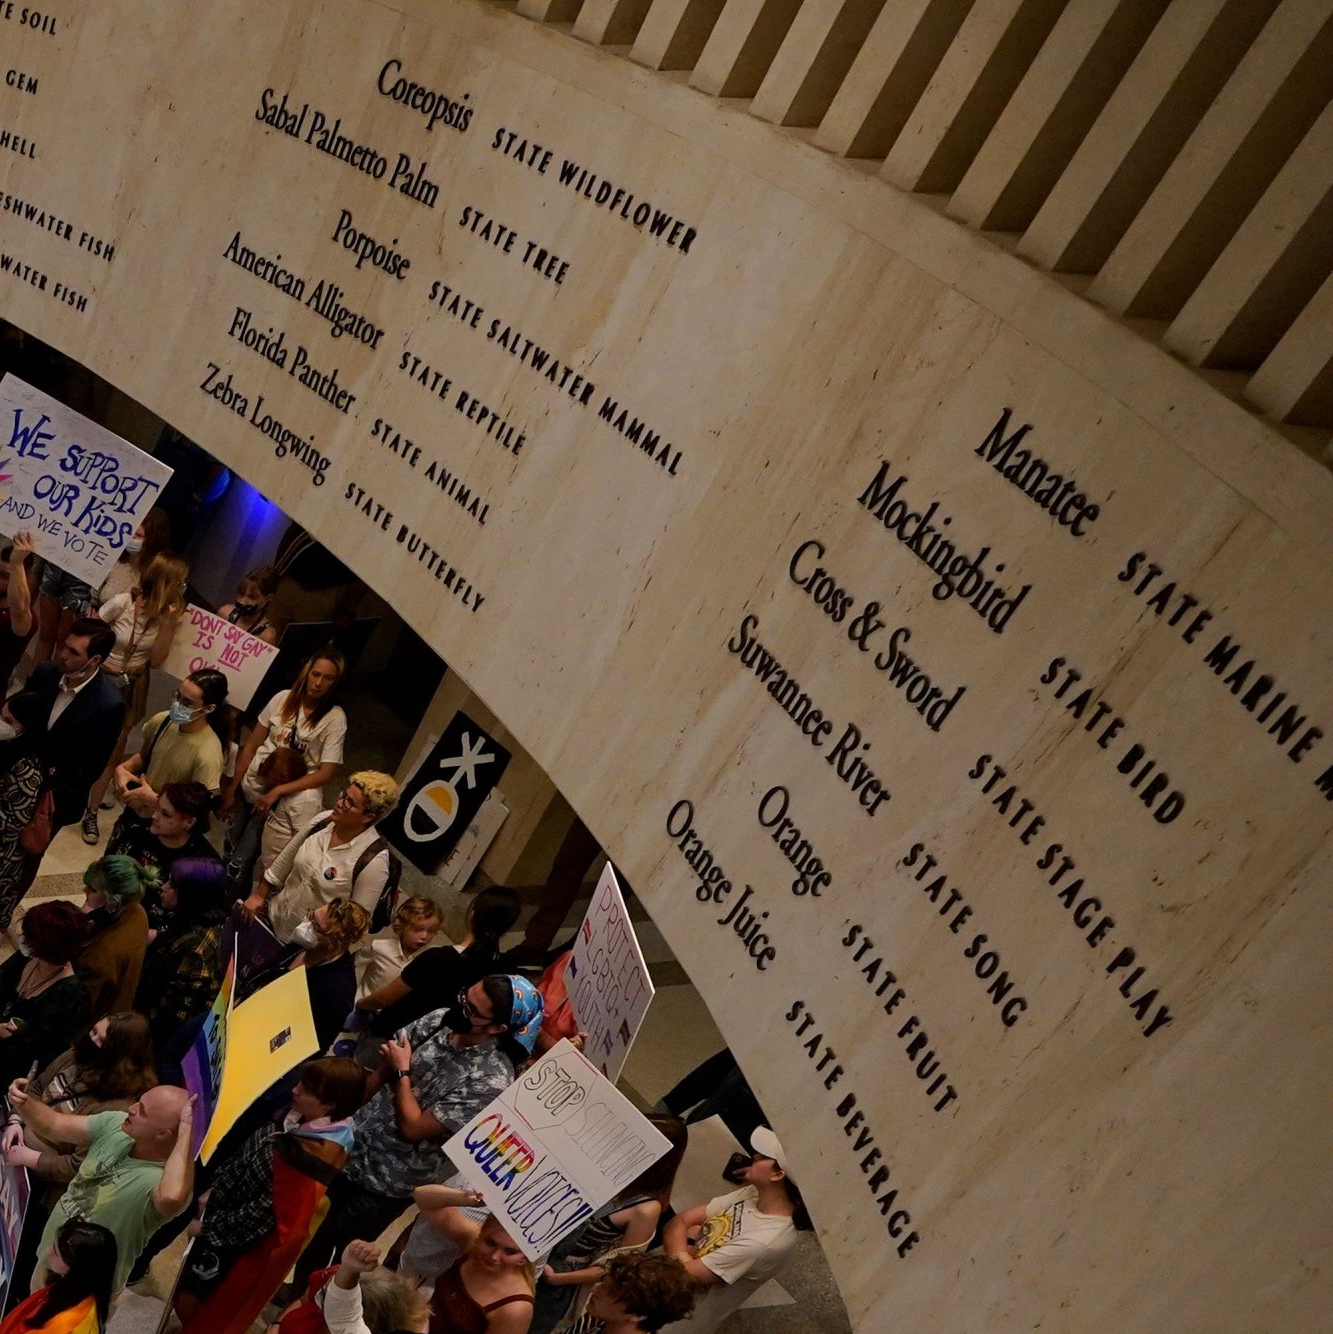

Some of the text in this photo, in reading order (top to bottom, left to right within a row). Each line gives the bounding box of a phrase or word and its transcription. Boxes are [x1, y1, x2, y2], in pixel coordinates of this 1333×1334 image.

[254, 87, 440, 209] Sabal Palmetto Palm
[377, 58, 474, 133] Coreopsis
[78, 231, 115, 263] FISH
[330, 209, 411, 281] Porpoise
[491, 127, 697, 255] STATE WILDFLOWER
[222, 231, 385, 351] American Alligator
[6, 408, 159, 515] WE SUPPORT
[199, 362, 333, 488] Zebra Longwing
[973, 407, 1100, 537] Manatee
[0, 496, 109, 566] AND WE VOTE
[33, 475, 80, 517] OUR
[856, 459, 1033, 635] Mockingbird
[192, 631, 249, 667] IS NOT
[224, 626, 242, 643] SAY
[1117, 551, 1324, 764] STATE MARINE
[727, 614, 892, 817] Suwannee River
[666, 799, 776, 971] Orange Juice
[595, 884, 645, 1011] PROTECT
[575, 976, 602, 1054] YOUTH
[524, 1060, 586, 1115] STOP
[785, 1000, 920, 1259] STATE BEVERAGE
[464, 1113, 536, 1191] QUEER
